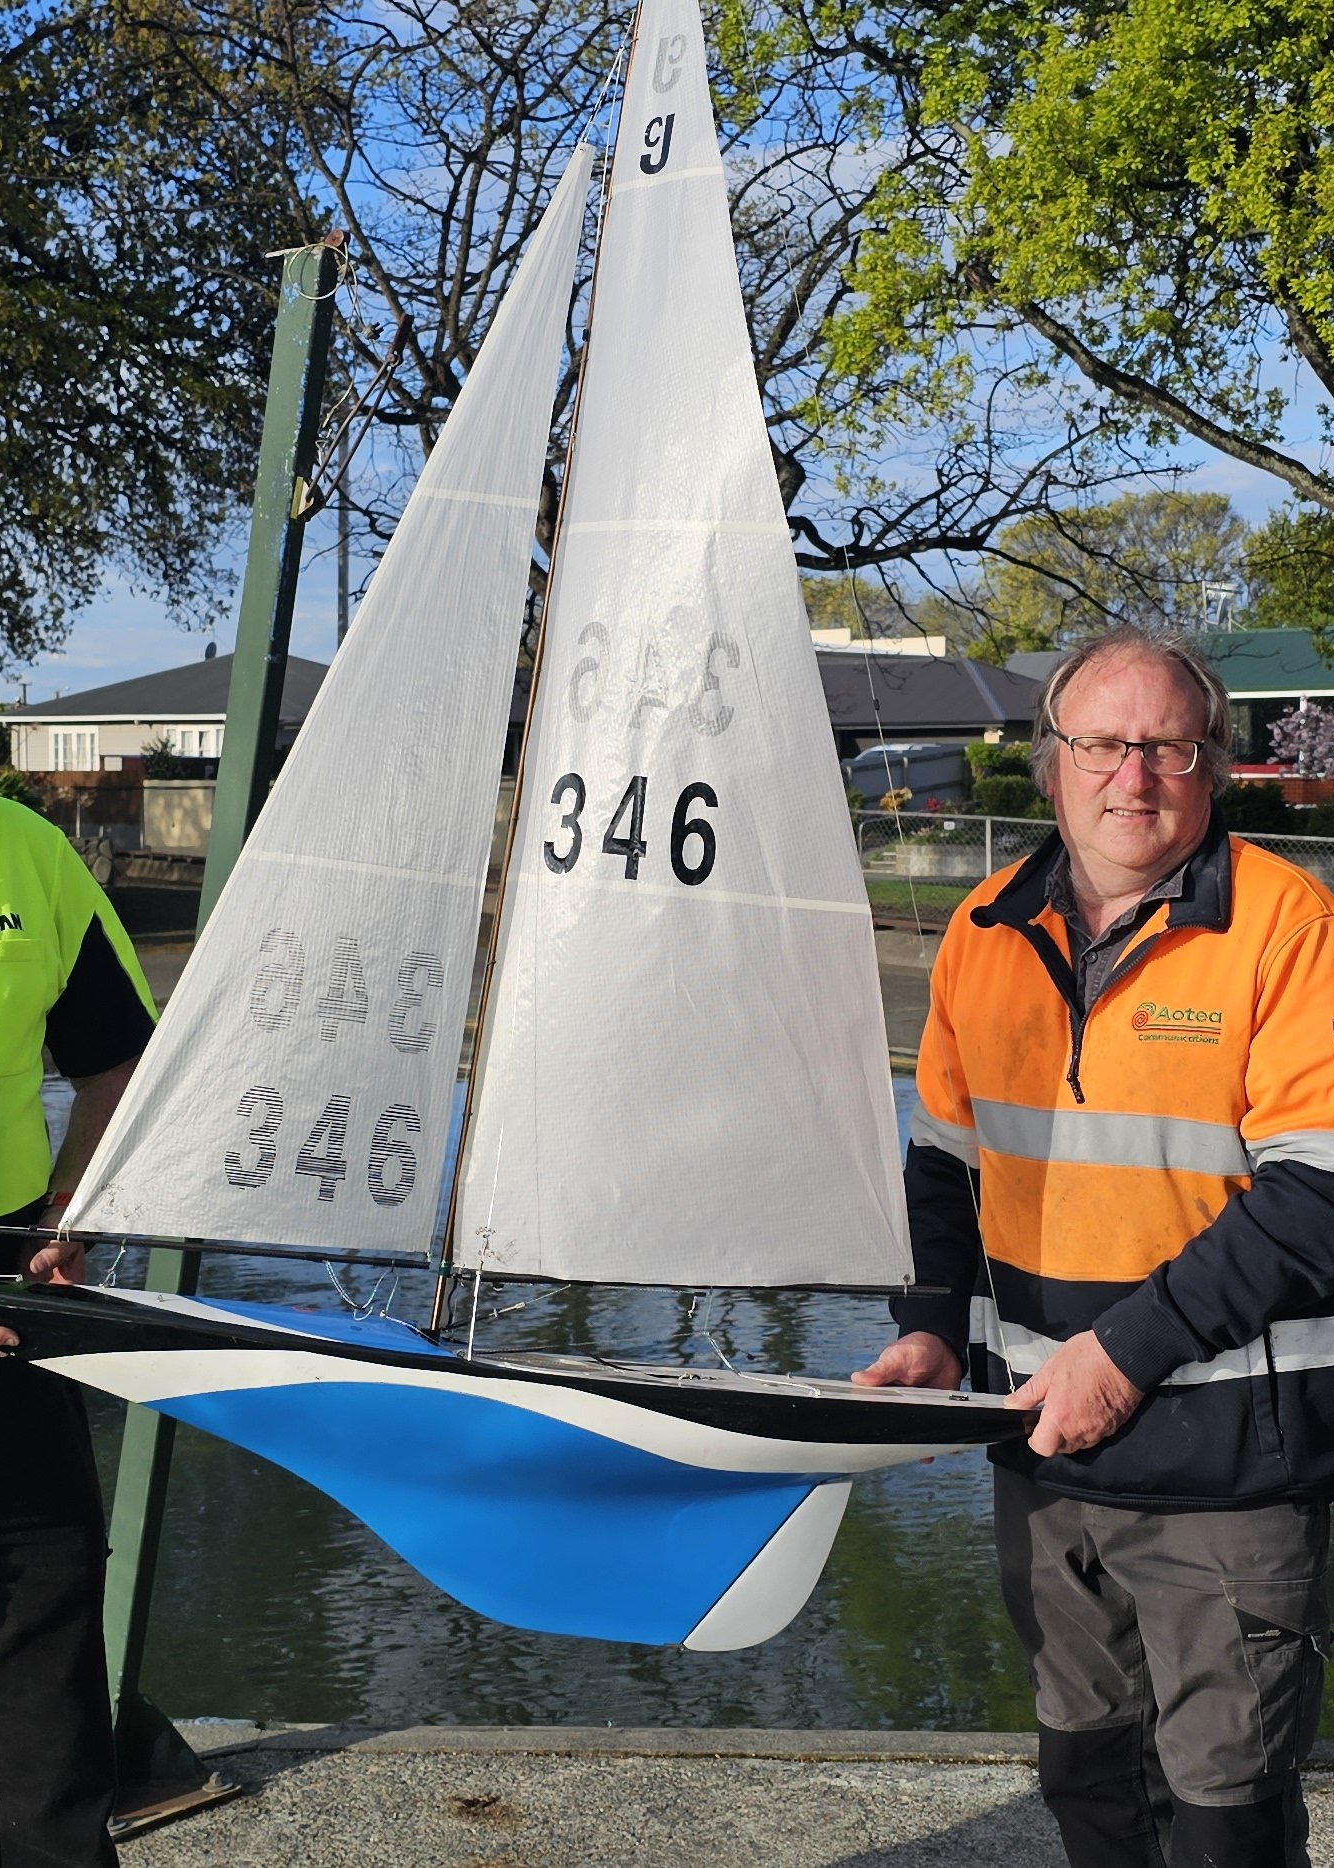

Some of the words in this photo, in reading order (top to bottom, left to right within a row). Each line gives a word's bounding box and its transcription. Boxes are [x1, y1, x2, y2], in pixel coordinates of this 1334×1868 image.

[543, 772, 719, 886] 346
[1156, 1006, 1222, 1023] Aotea
[223, 1084, 421, 1208] 346
